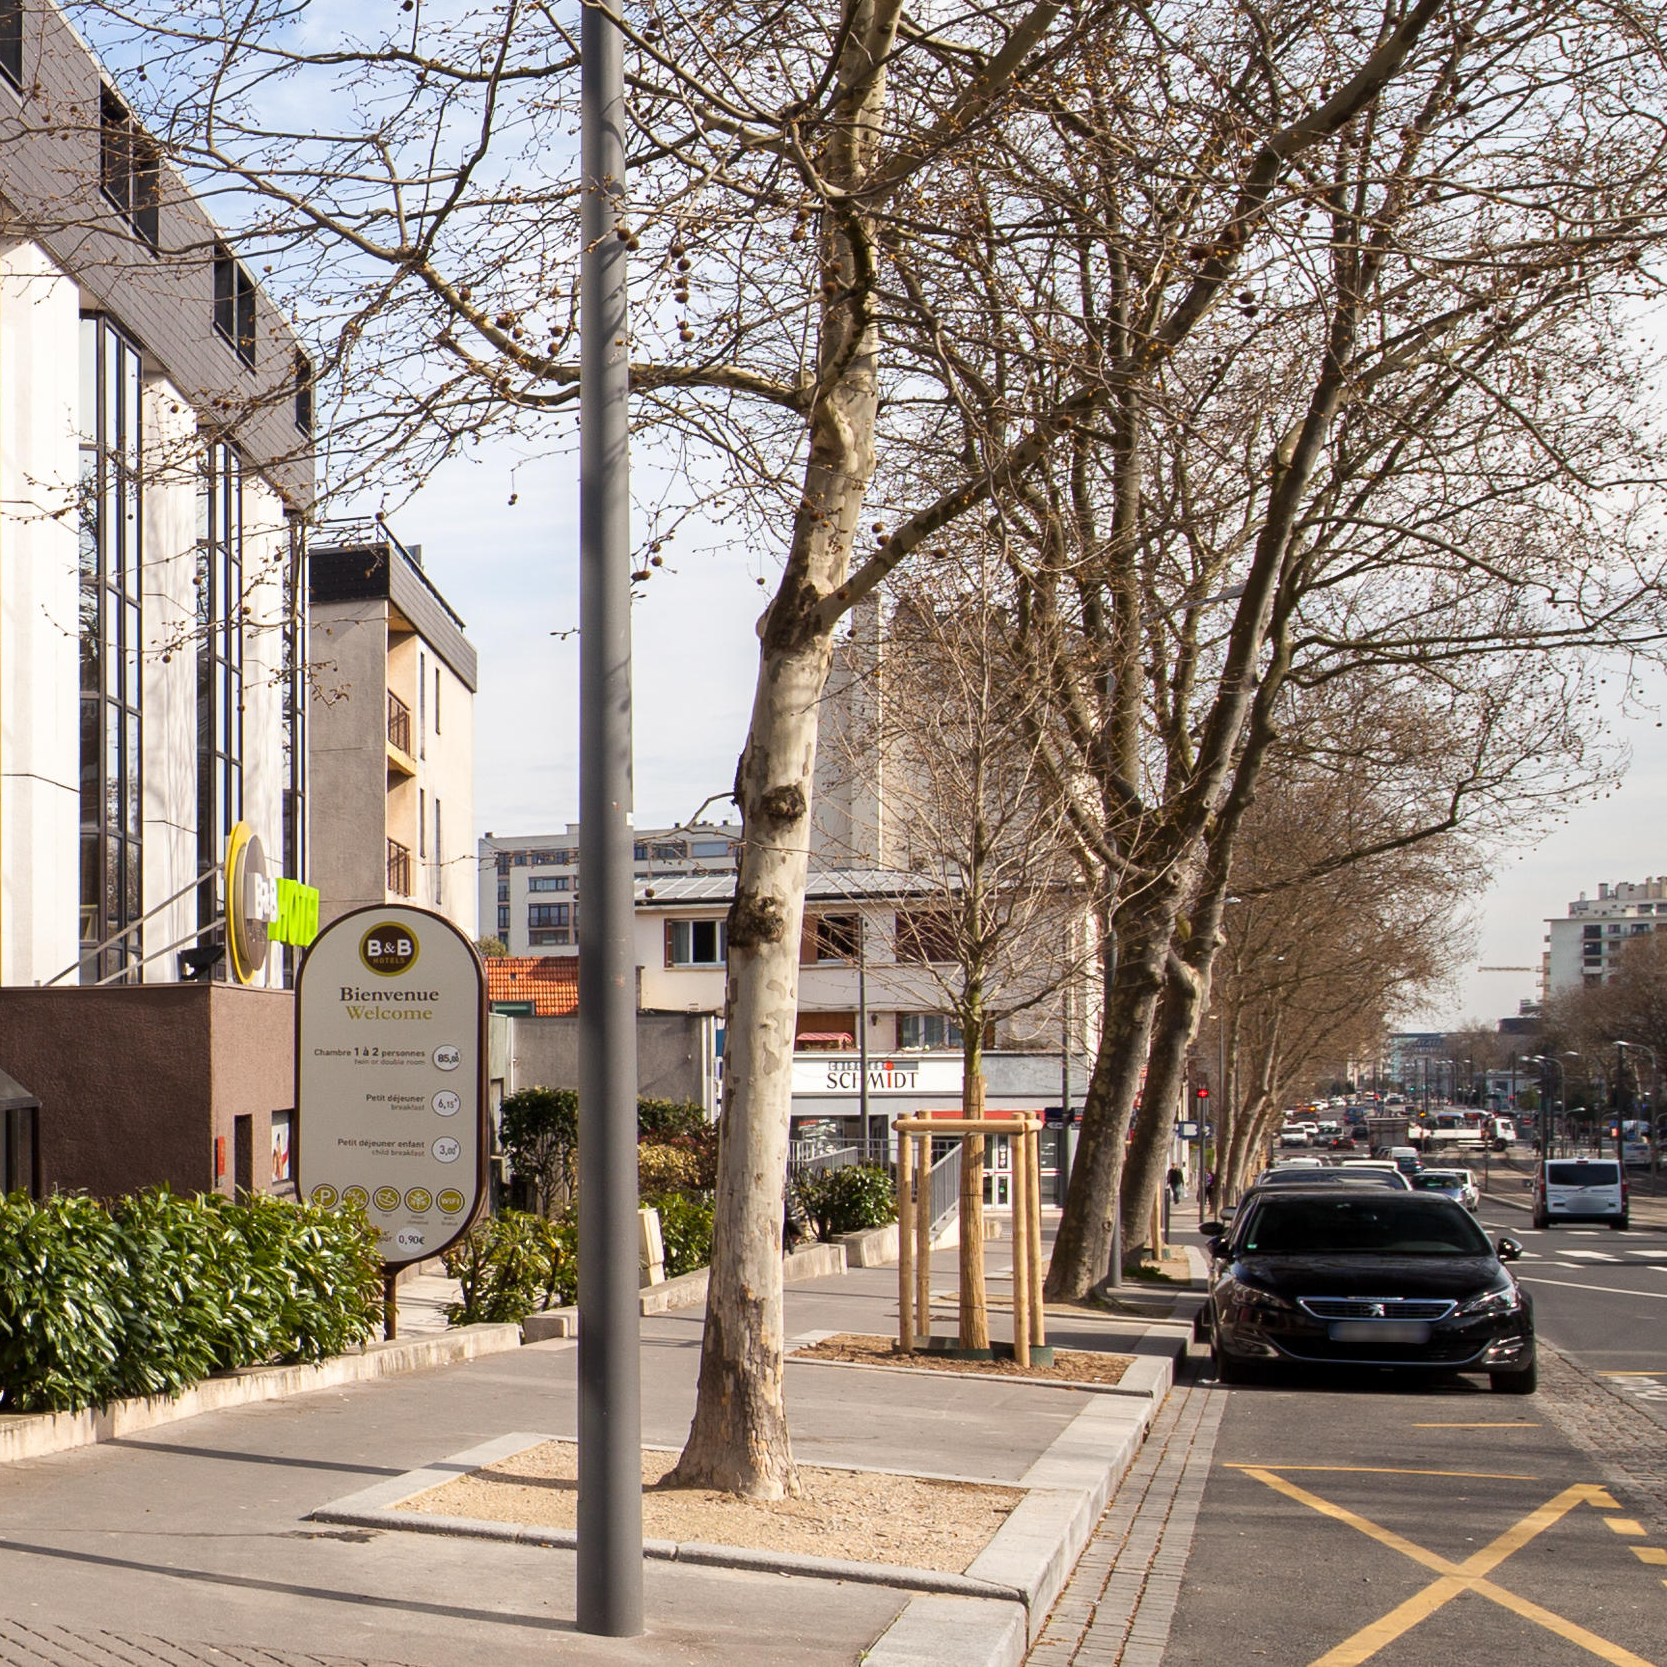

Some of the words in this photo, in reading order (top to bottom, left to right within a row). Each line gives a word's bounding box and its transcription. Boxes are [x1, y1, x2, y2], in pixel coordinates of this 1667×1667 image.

[367, 939, 412, 957] B&B
[339, 986, 440, 1002] Bienvenue
[345, 1005, 434, 1021] Welcome
[314, 1047, 351, 1057] Chambre
[354, 1047, 360, 1057] 1
[372, 1047, 379, 1057] 2
[381, 1050, 426, 1059] personnes
[366, 1094, 386, 1102] Petit
[387, 1094, 426, 1103] déjeuner
[337, 1138, 357, 1146] Petit
[358, 1139, 396, 1148] déjeuner
[397, 1140, 426, 1148] enfant
